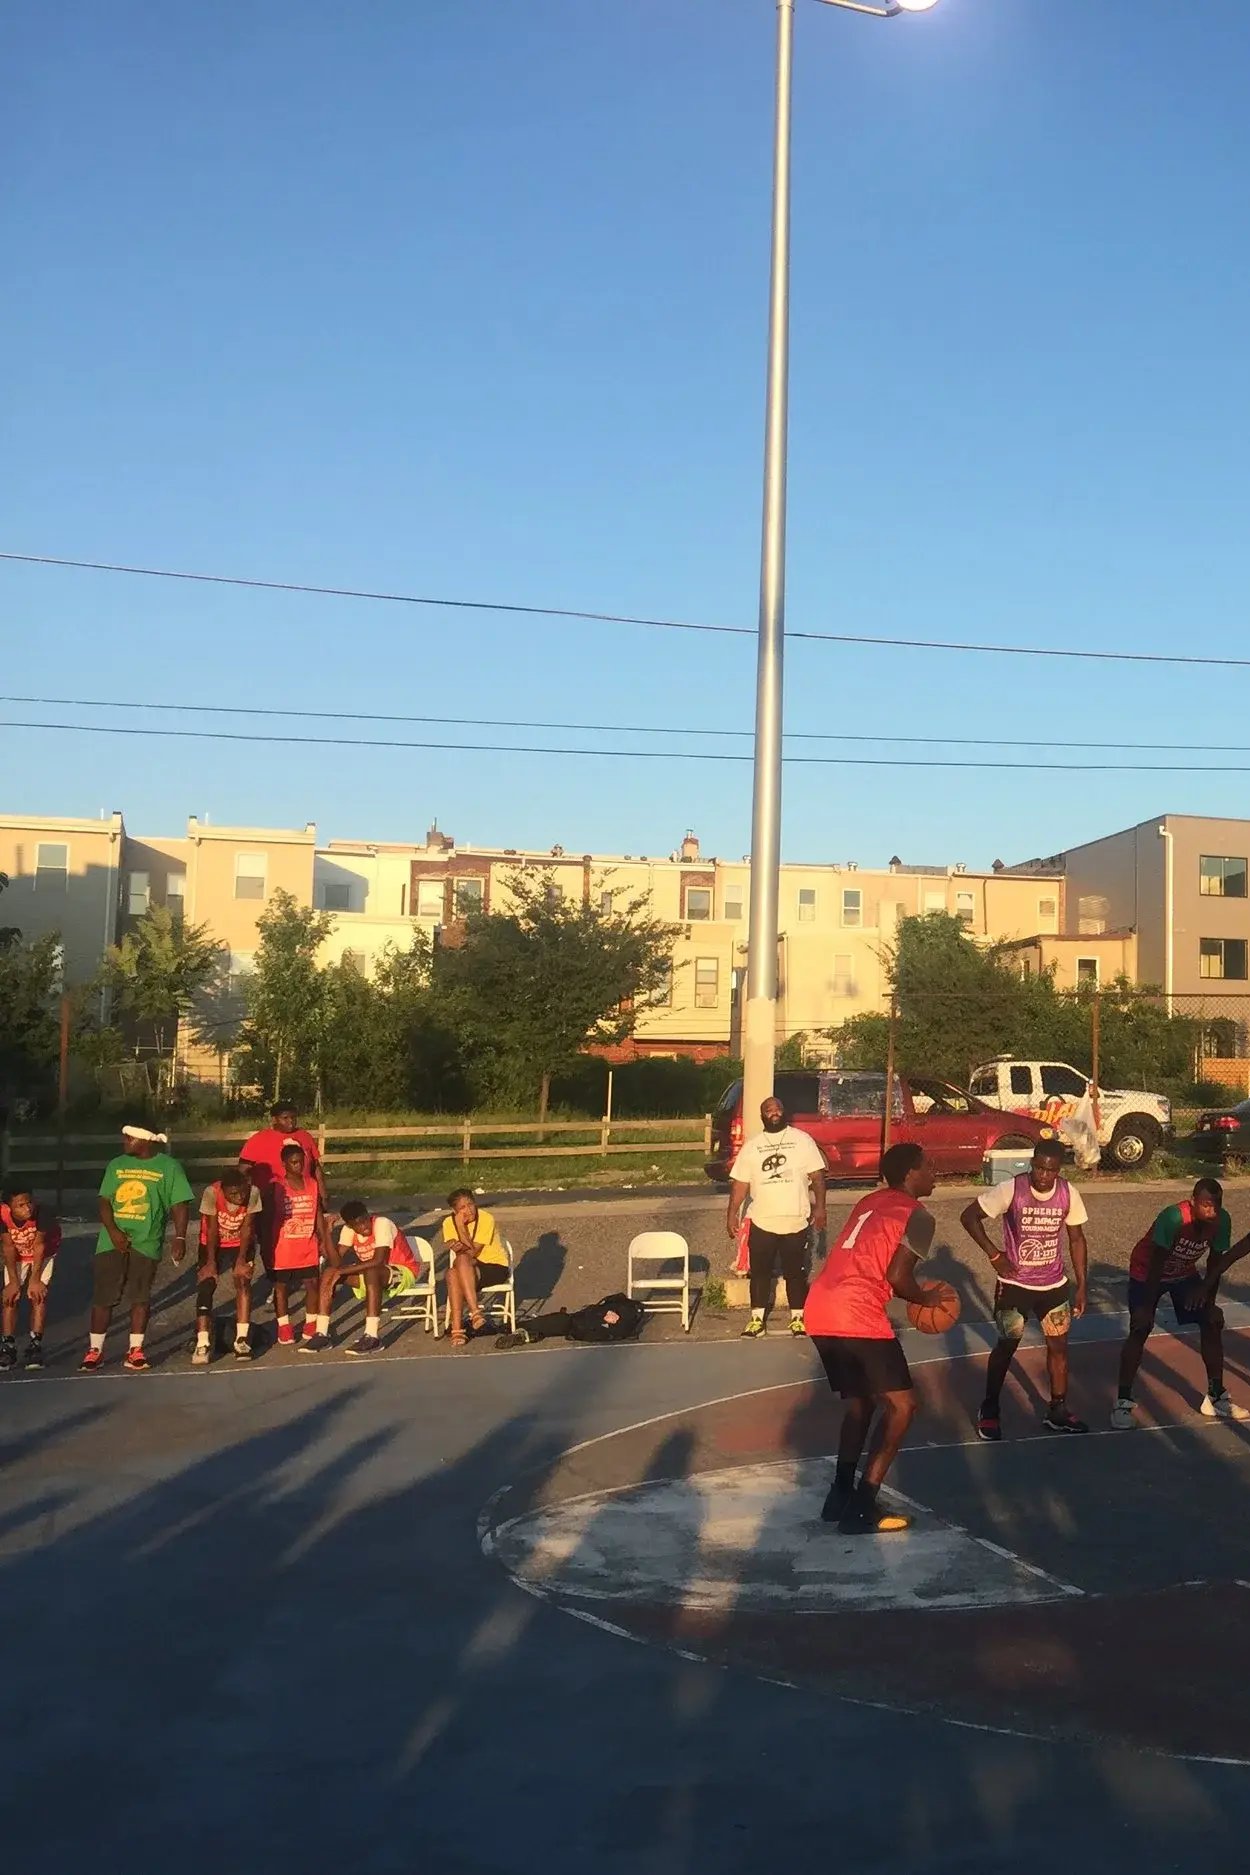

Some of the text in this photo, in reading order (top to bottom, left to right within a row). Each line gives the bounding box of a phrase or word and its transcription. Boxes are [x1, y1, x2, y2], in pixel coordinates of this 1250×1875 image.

[1022, 1207, 1062, 1216] SPHERES
[1021, 1216, 1061, 1225] OF IMPACT
[841, 1209, 873, 1249] 1
